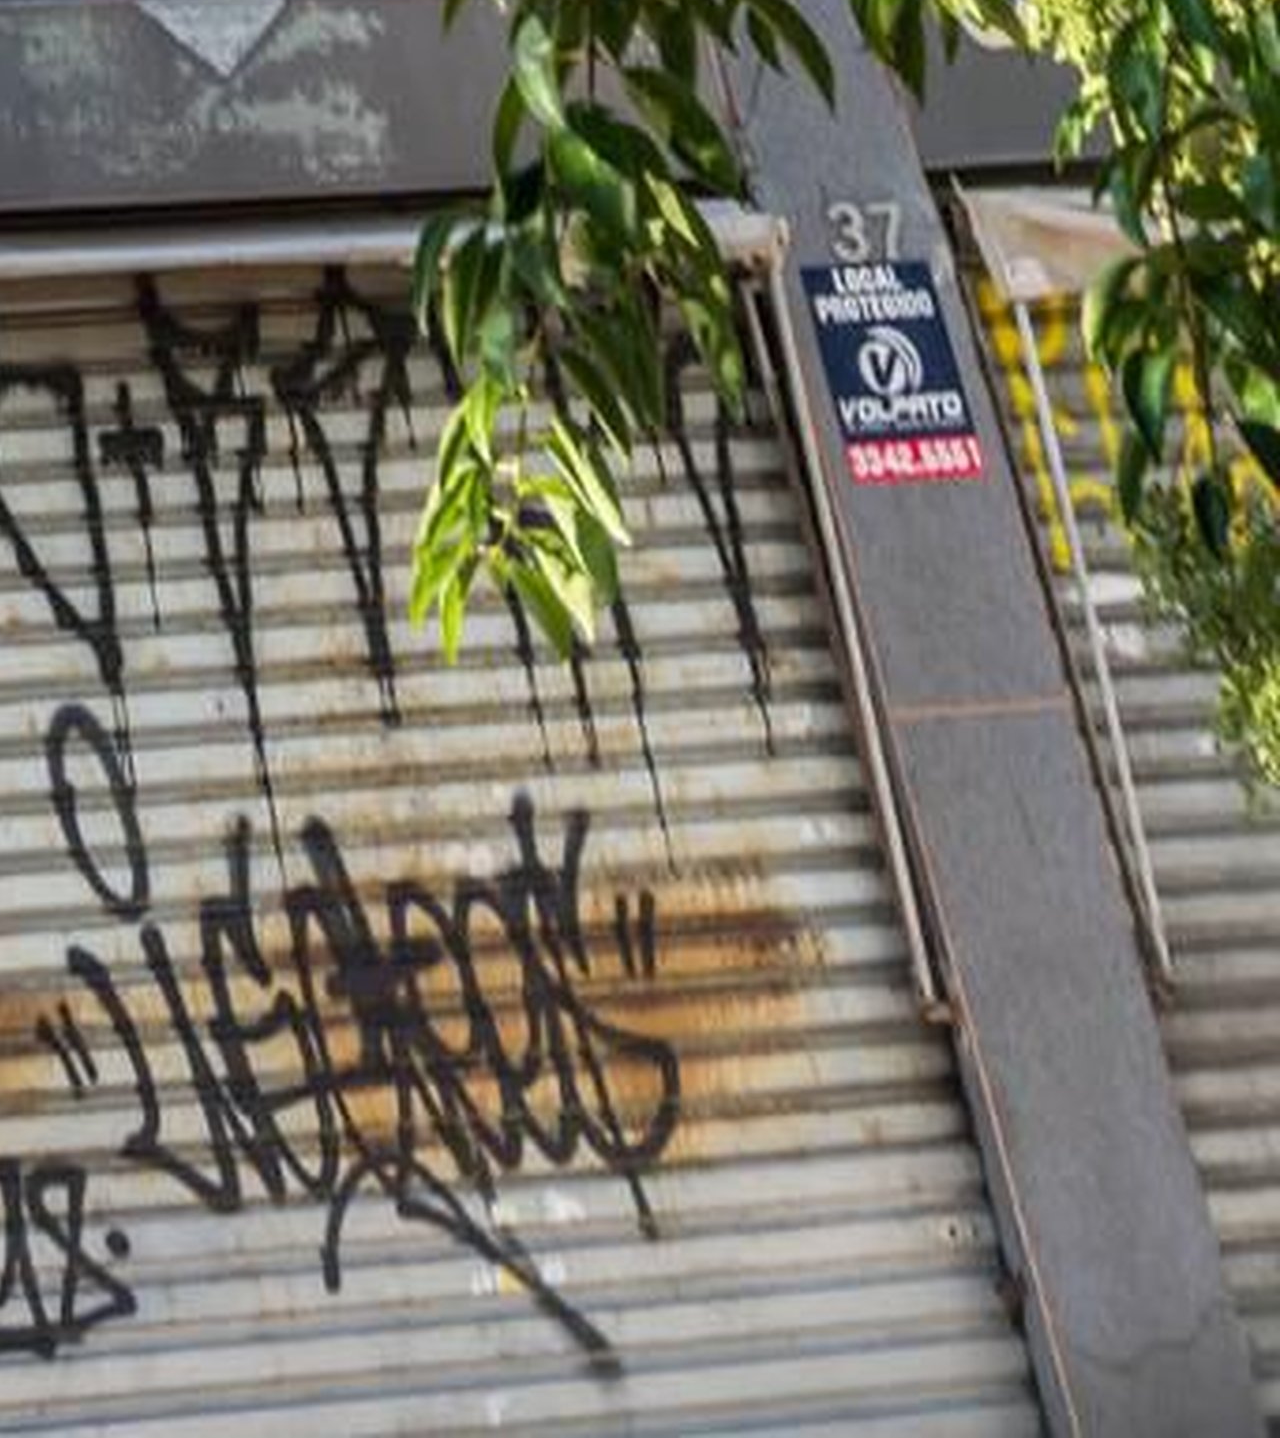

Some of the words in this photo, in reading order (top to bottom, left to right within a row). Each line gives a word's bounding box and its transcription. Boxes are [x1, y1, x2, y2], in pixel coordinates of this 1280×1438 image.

[828, 200, 903, 262] 37
[831, 264, 902, 291] LOCAL
[815, 291, 935, 323] PROTEGIDO
[840, 390, 963, 425] VOLPATO
